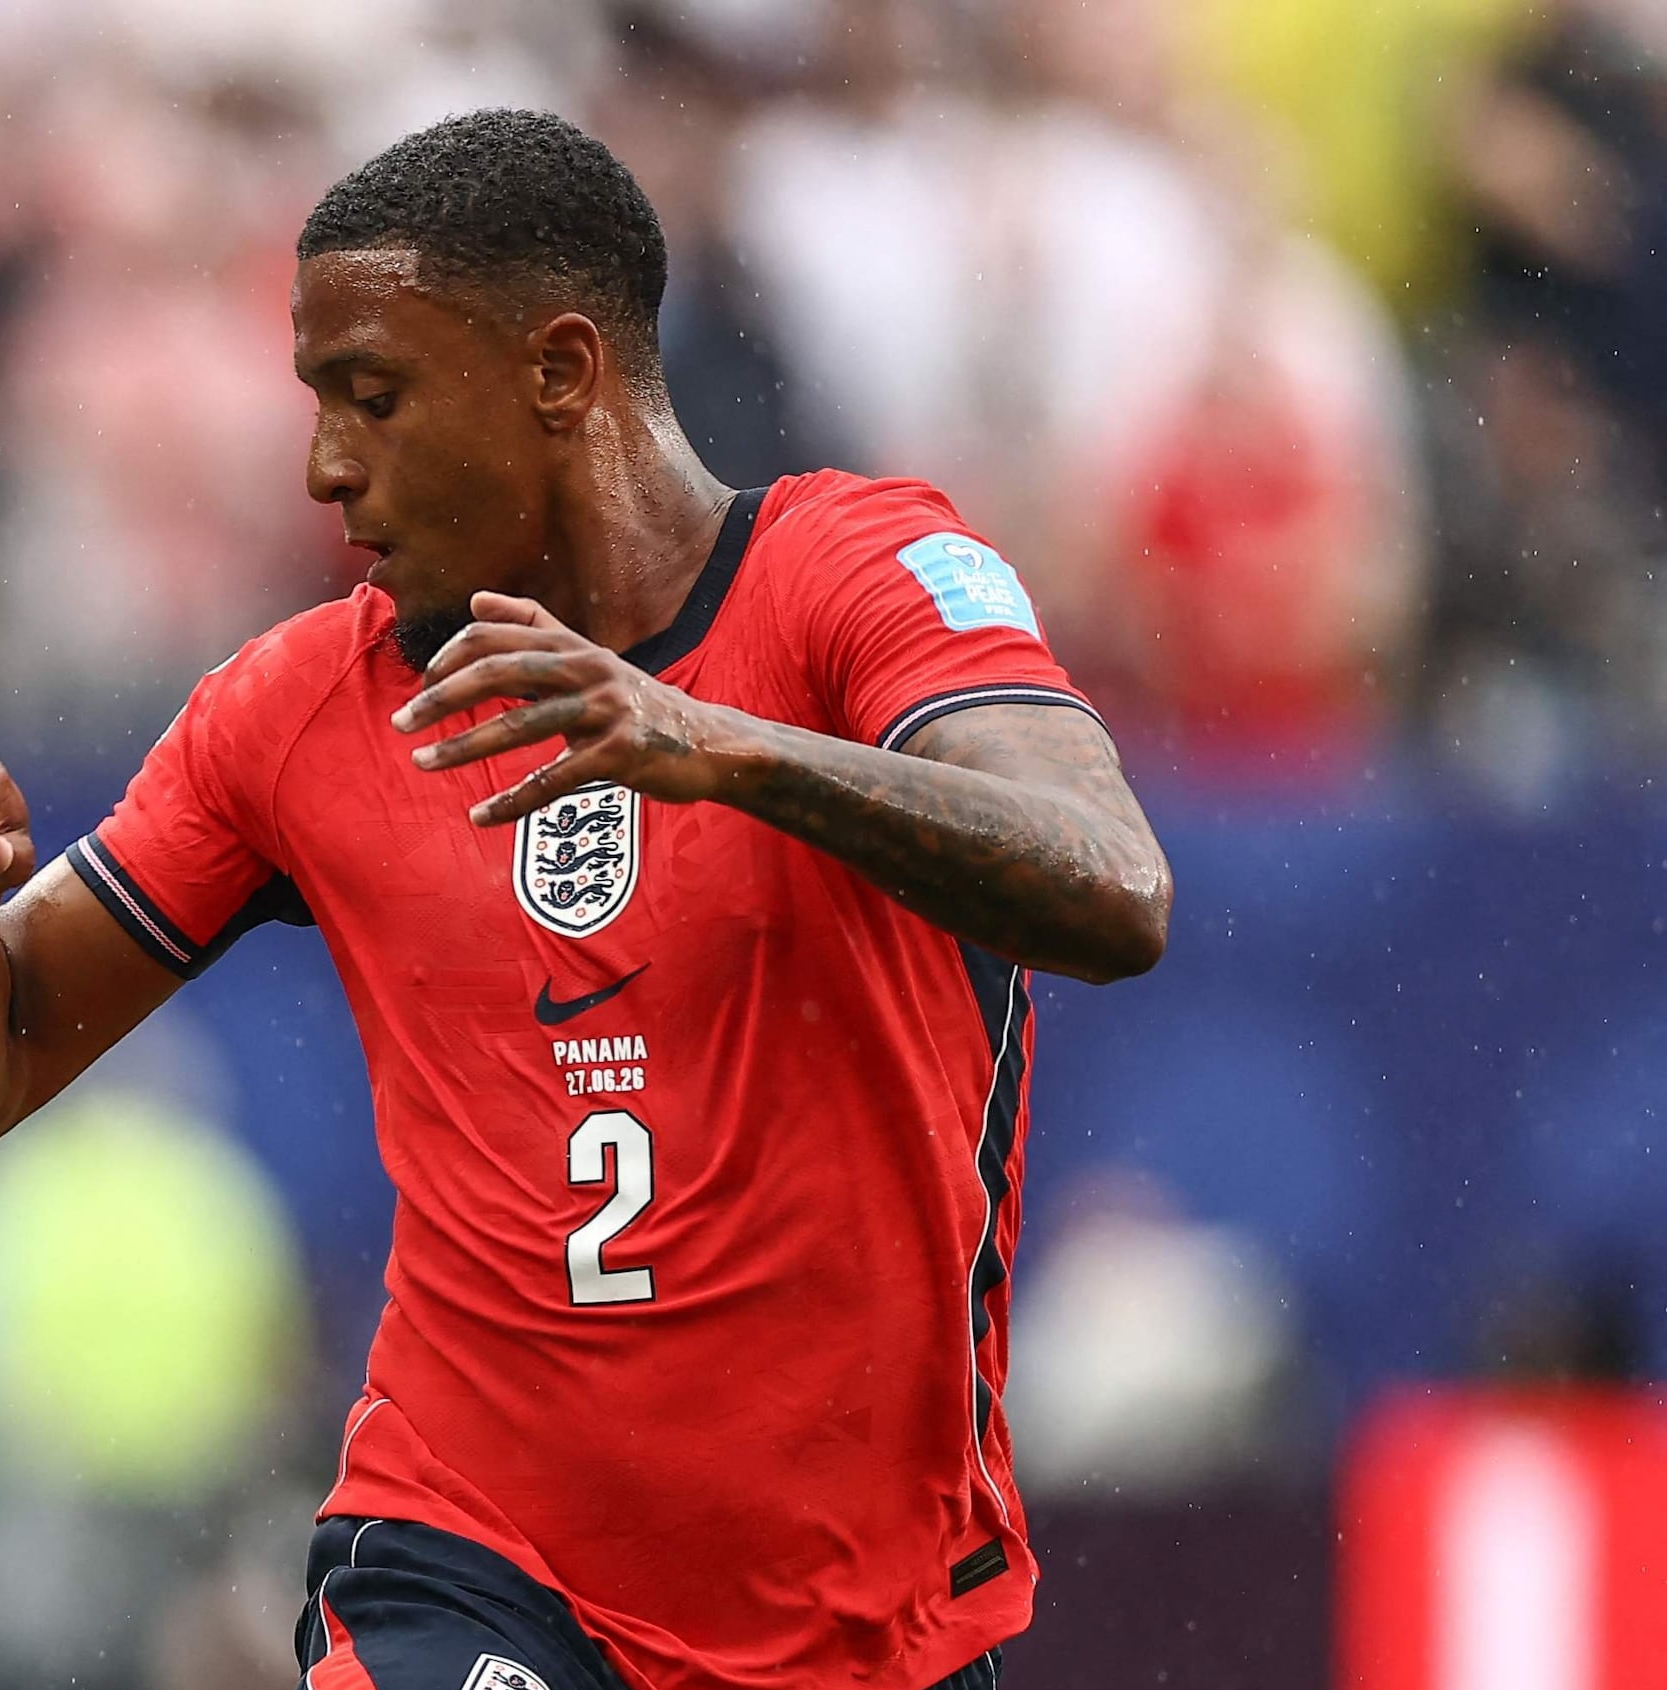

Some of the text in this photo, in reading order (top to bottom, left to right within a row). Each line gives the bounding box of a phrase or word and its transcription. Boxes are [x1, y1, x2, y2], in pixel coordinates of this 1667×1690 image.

[552, 1035, 648, 1066] PANAMA
[565, 1066, 645, 1096] 27.06.26
[567, 1109, 656, 1307] 2
